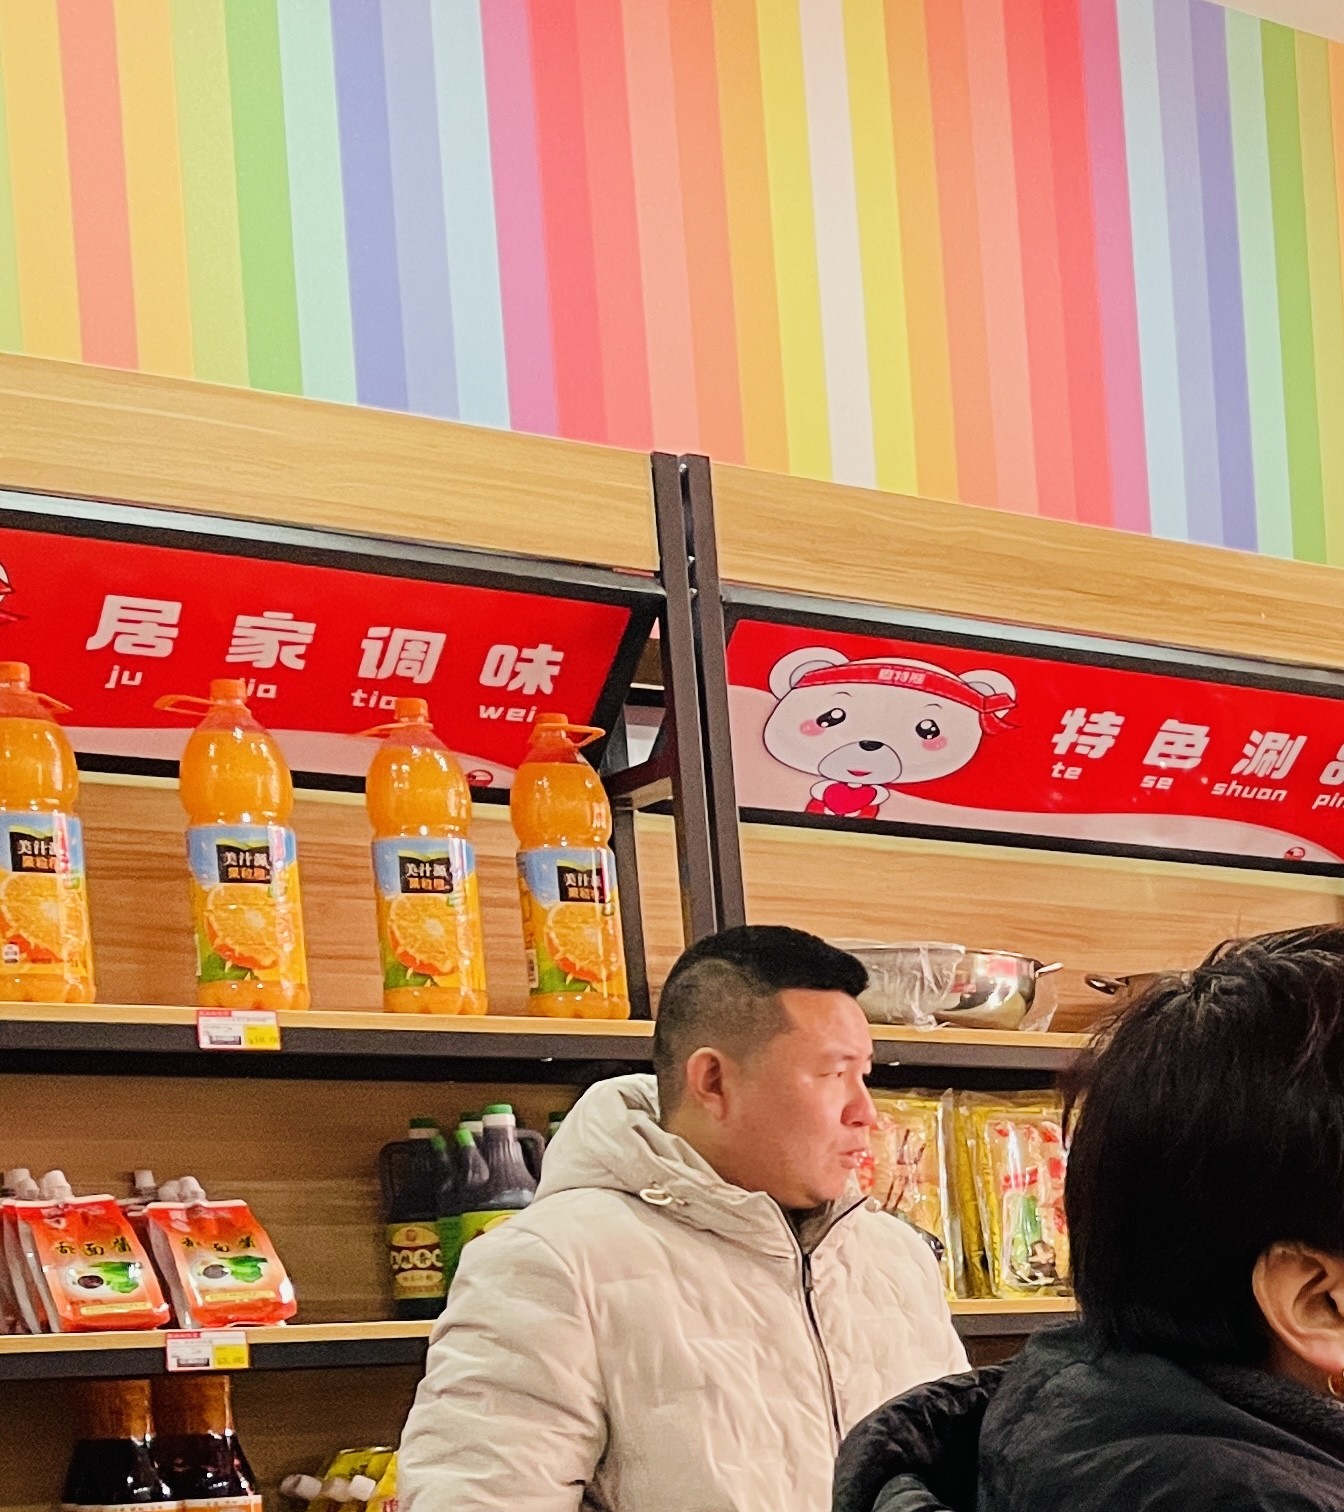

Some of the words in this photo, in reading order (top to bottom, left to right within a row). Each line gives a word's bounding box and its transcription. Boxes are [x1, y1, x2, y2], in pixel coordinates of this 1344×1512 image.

[86, 594, 564, 697] 居家调味
[104, 664, 143, 689] ju
[239, 678, 278, 699] ia
[350, 688, 396, 710] tia
[478, 704, 538, 723] wei
[1051, 761, 1083, 780] te
[1140, 775, 1173, 791] se
[1211, 780, 1287, 802] shuan
